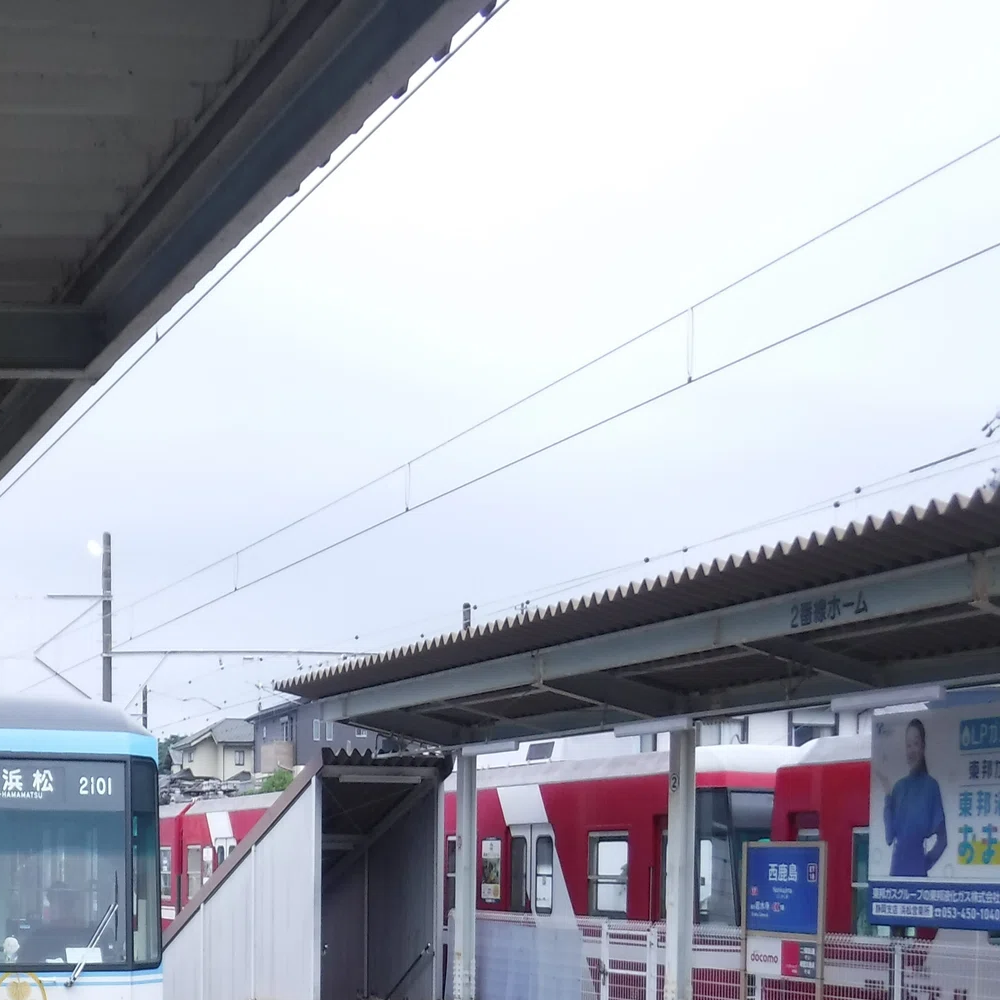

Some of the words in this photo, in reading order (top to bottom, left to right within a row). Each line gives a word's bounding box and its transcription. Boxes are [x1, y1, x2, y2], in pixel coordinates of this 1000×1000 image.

[79, 776, 112, 796] 2101
[768, 863, 798, 882] 西鹿島
[750, 951, 779, 964] docomo
